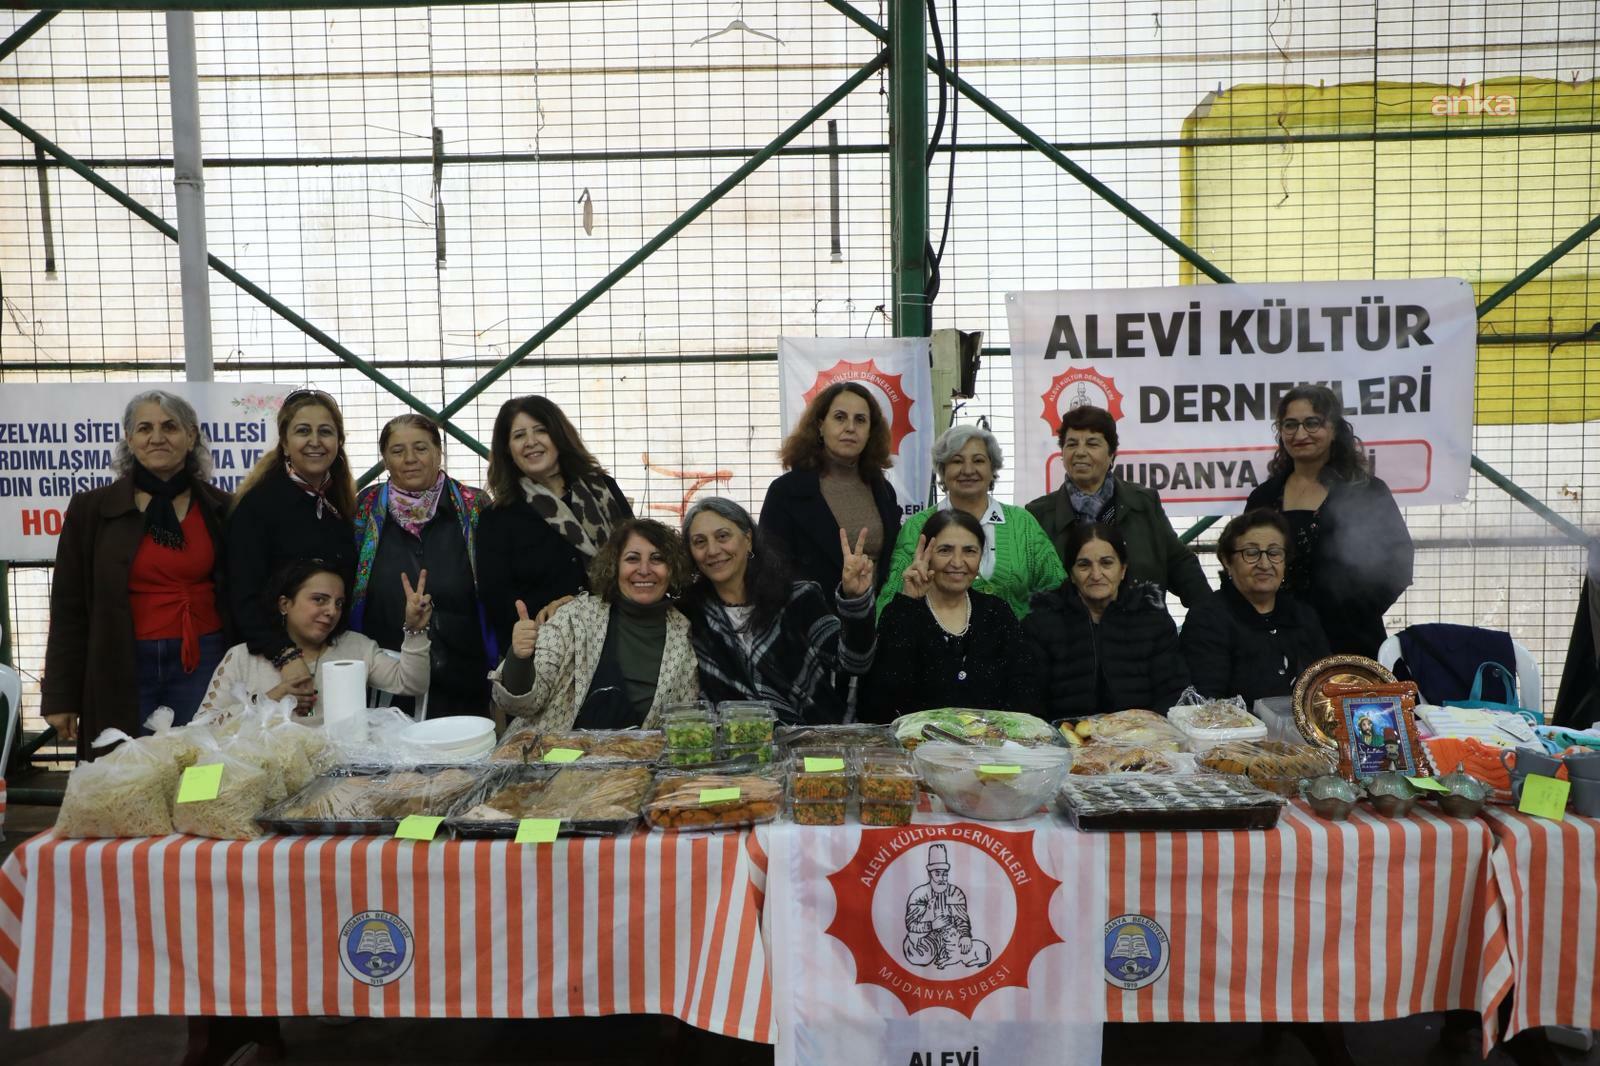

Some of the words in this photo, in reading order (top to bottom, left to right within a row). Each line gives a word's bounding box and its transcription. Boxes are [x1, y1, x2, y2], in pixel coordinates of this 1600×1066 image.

[1044, 301, 1201, 360] ALEVİ
[1219, 296, 1434, 355] KÜLTÜR
[1140, 365, 1432, 424] DERNELERİ
[201, 418, 266, 443] ALLESİ
[21, 508, 69, 536] HO
[861, 846, 892, 888] ALEVİ
[890, 827, 948, 853] KÜLTÜR
[952, 828, 1032, 886] DERNEKLERİ
[343, 913, 370, 937] MUDANYA
[1105, 917, 1127, 935] DANYA
[878, 966, 955, 1000] MUDANYA
